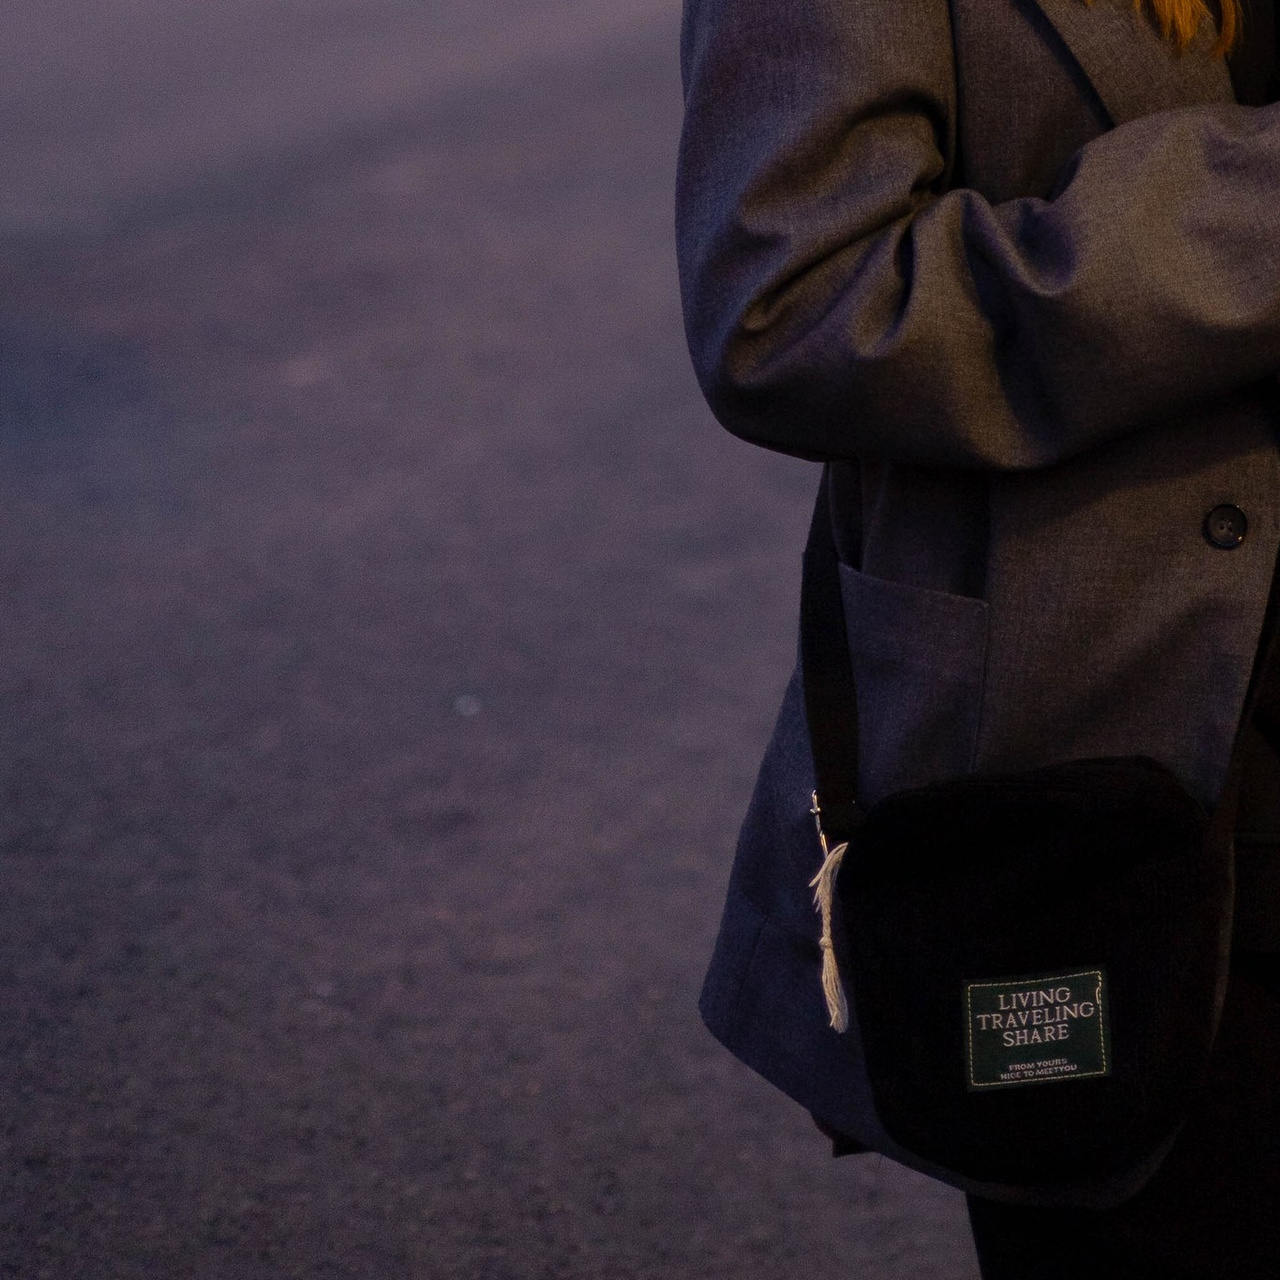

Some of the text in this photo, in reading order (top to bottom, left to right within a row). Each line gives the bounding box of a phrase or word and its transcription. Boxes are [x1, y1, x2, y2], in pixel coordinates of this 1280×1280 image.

[998, 987, 1071, 1010] LIVING
[976, 1002, 1094, 1030] TRAVELING
[1003, 1023, 1070, 1047] SHARE
[1009, 1062, 1035, 1071] FROM
